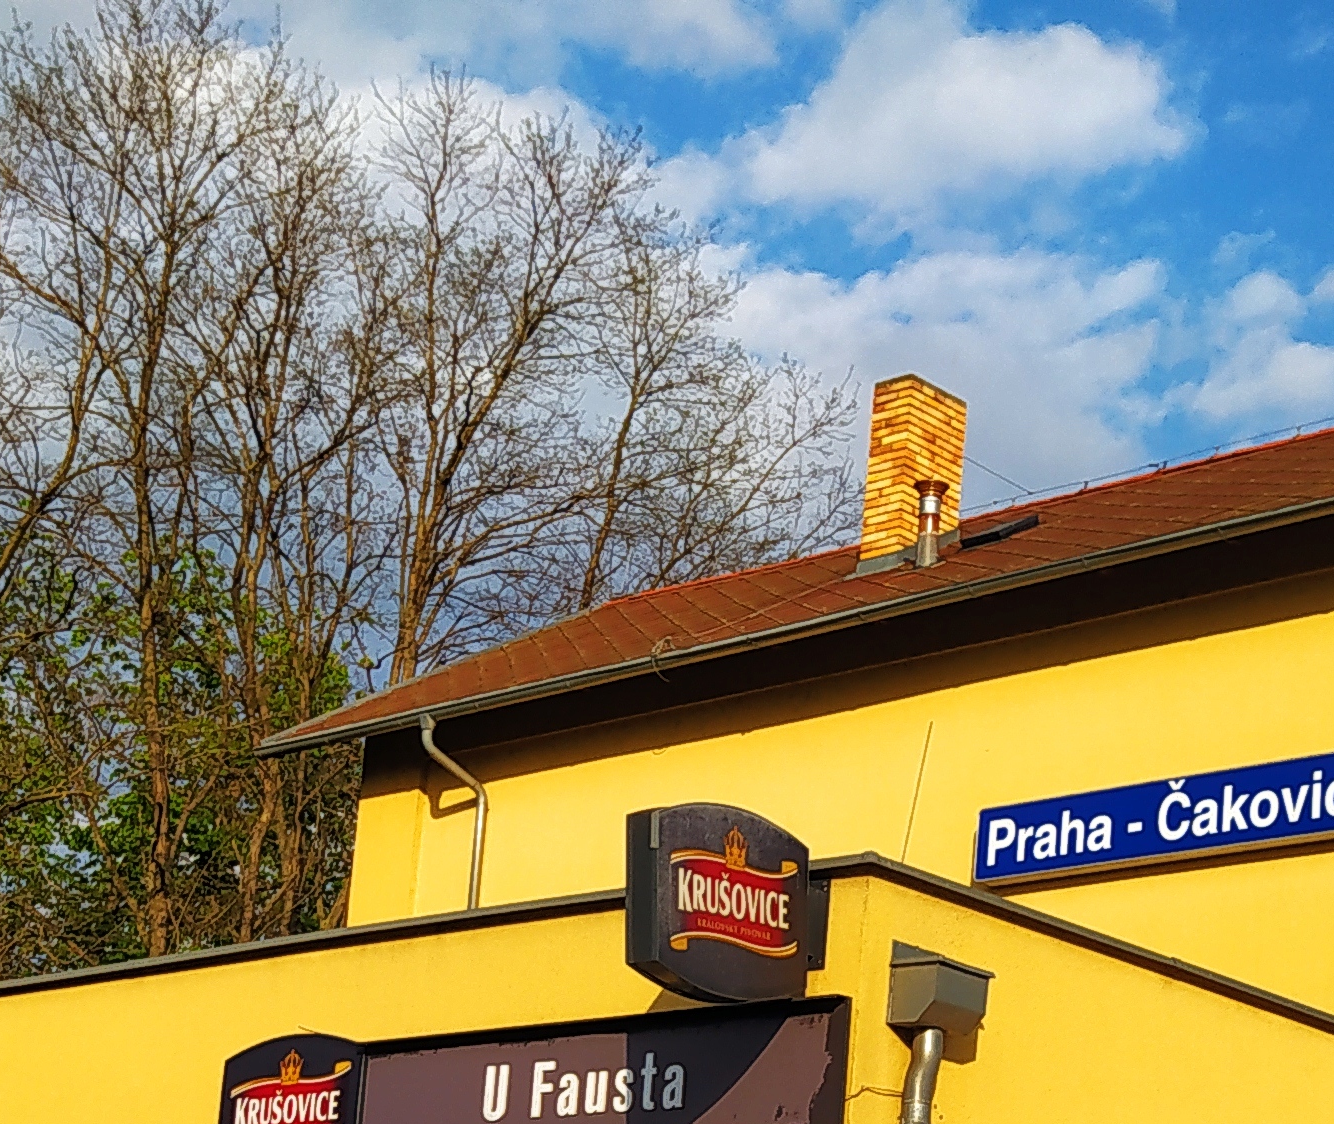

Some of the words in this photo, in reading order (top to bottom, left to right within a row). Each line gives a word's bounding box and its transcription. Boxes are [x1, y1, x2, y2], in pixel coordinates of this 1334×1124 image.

[986, 810, 1112, 867] Praha
[678, 867, 790, 930] KRUŠOVICE
[482, 1064, 510, 1122] U
[530, 1052, 686, 1119] Fausta
